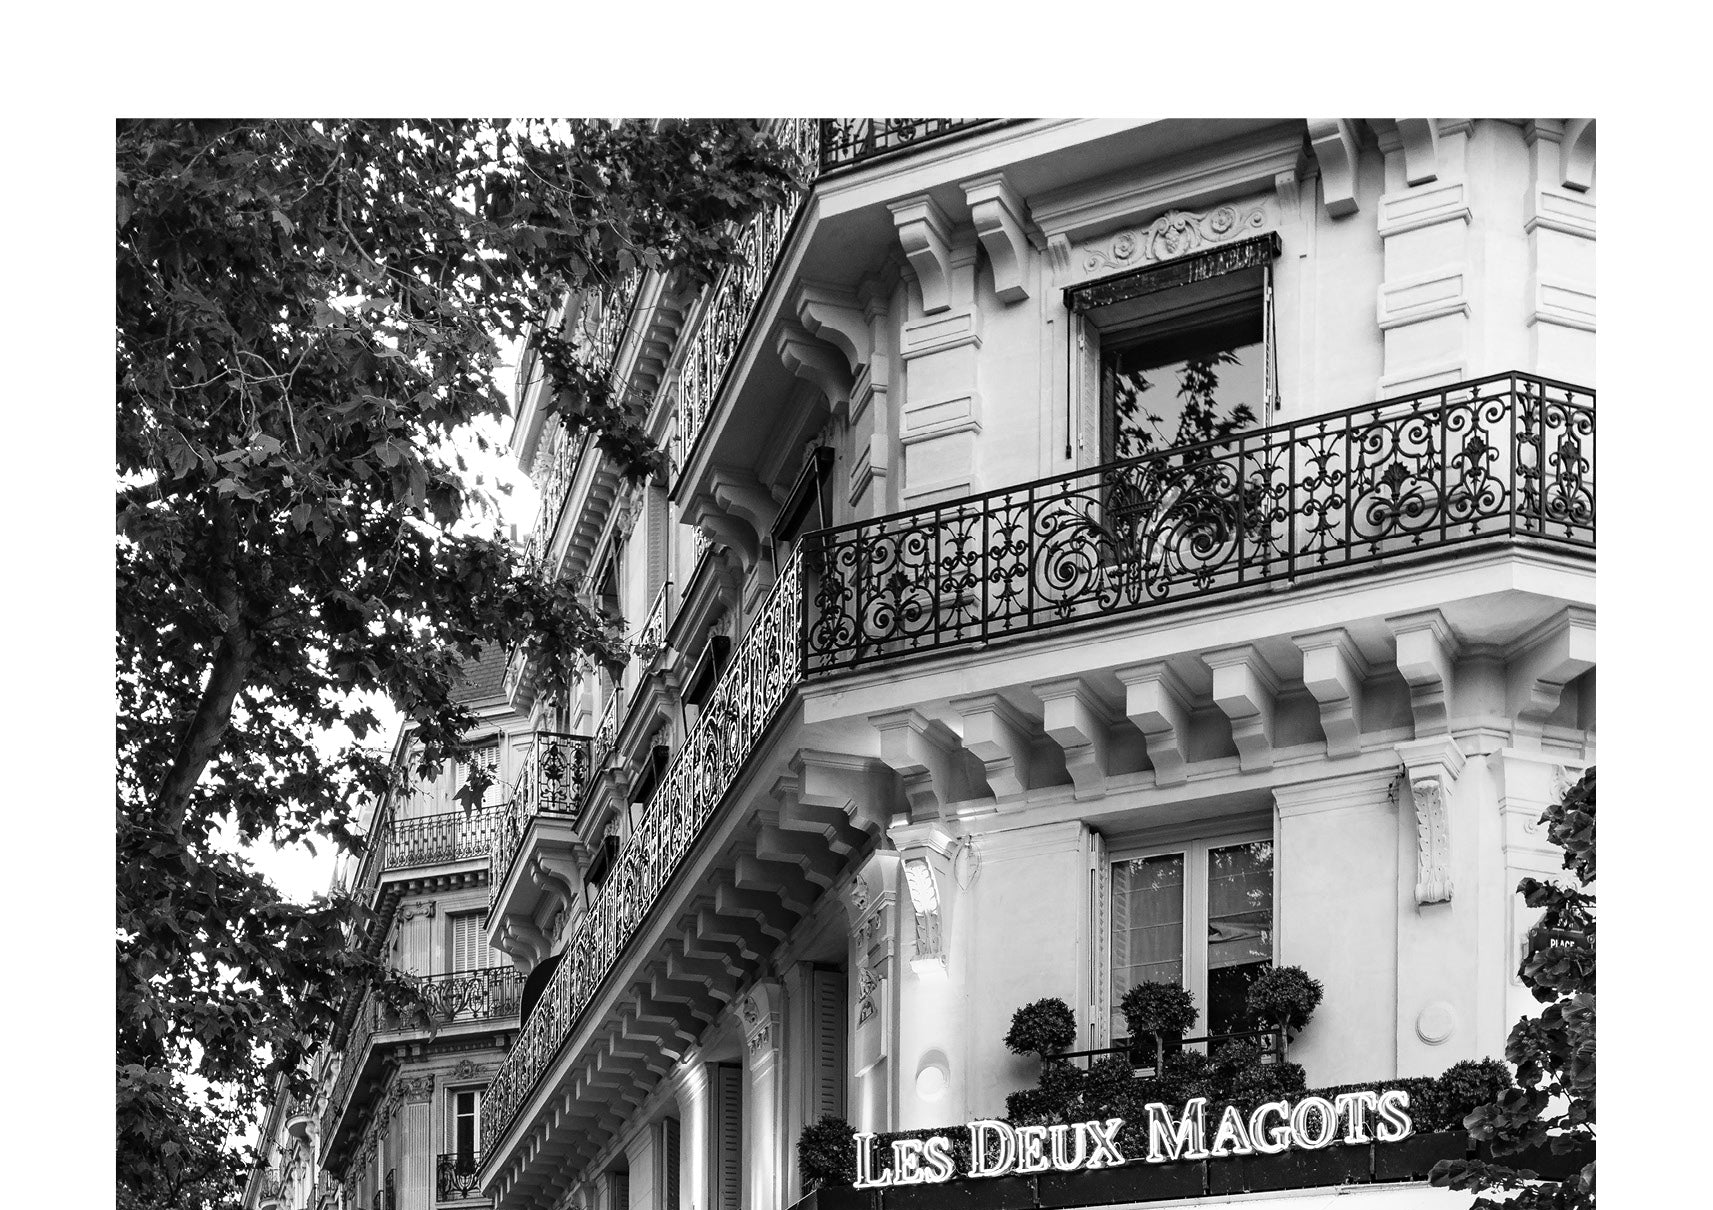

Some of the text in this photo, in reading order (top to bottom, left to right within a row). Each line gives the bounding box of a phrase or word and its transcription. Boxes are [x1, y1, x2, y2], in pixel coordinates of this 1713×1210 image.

[1550, 938, 1575, 948] PLACE
[853, 1090, 1414, 1188] LES DEUX MAGOTS
